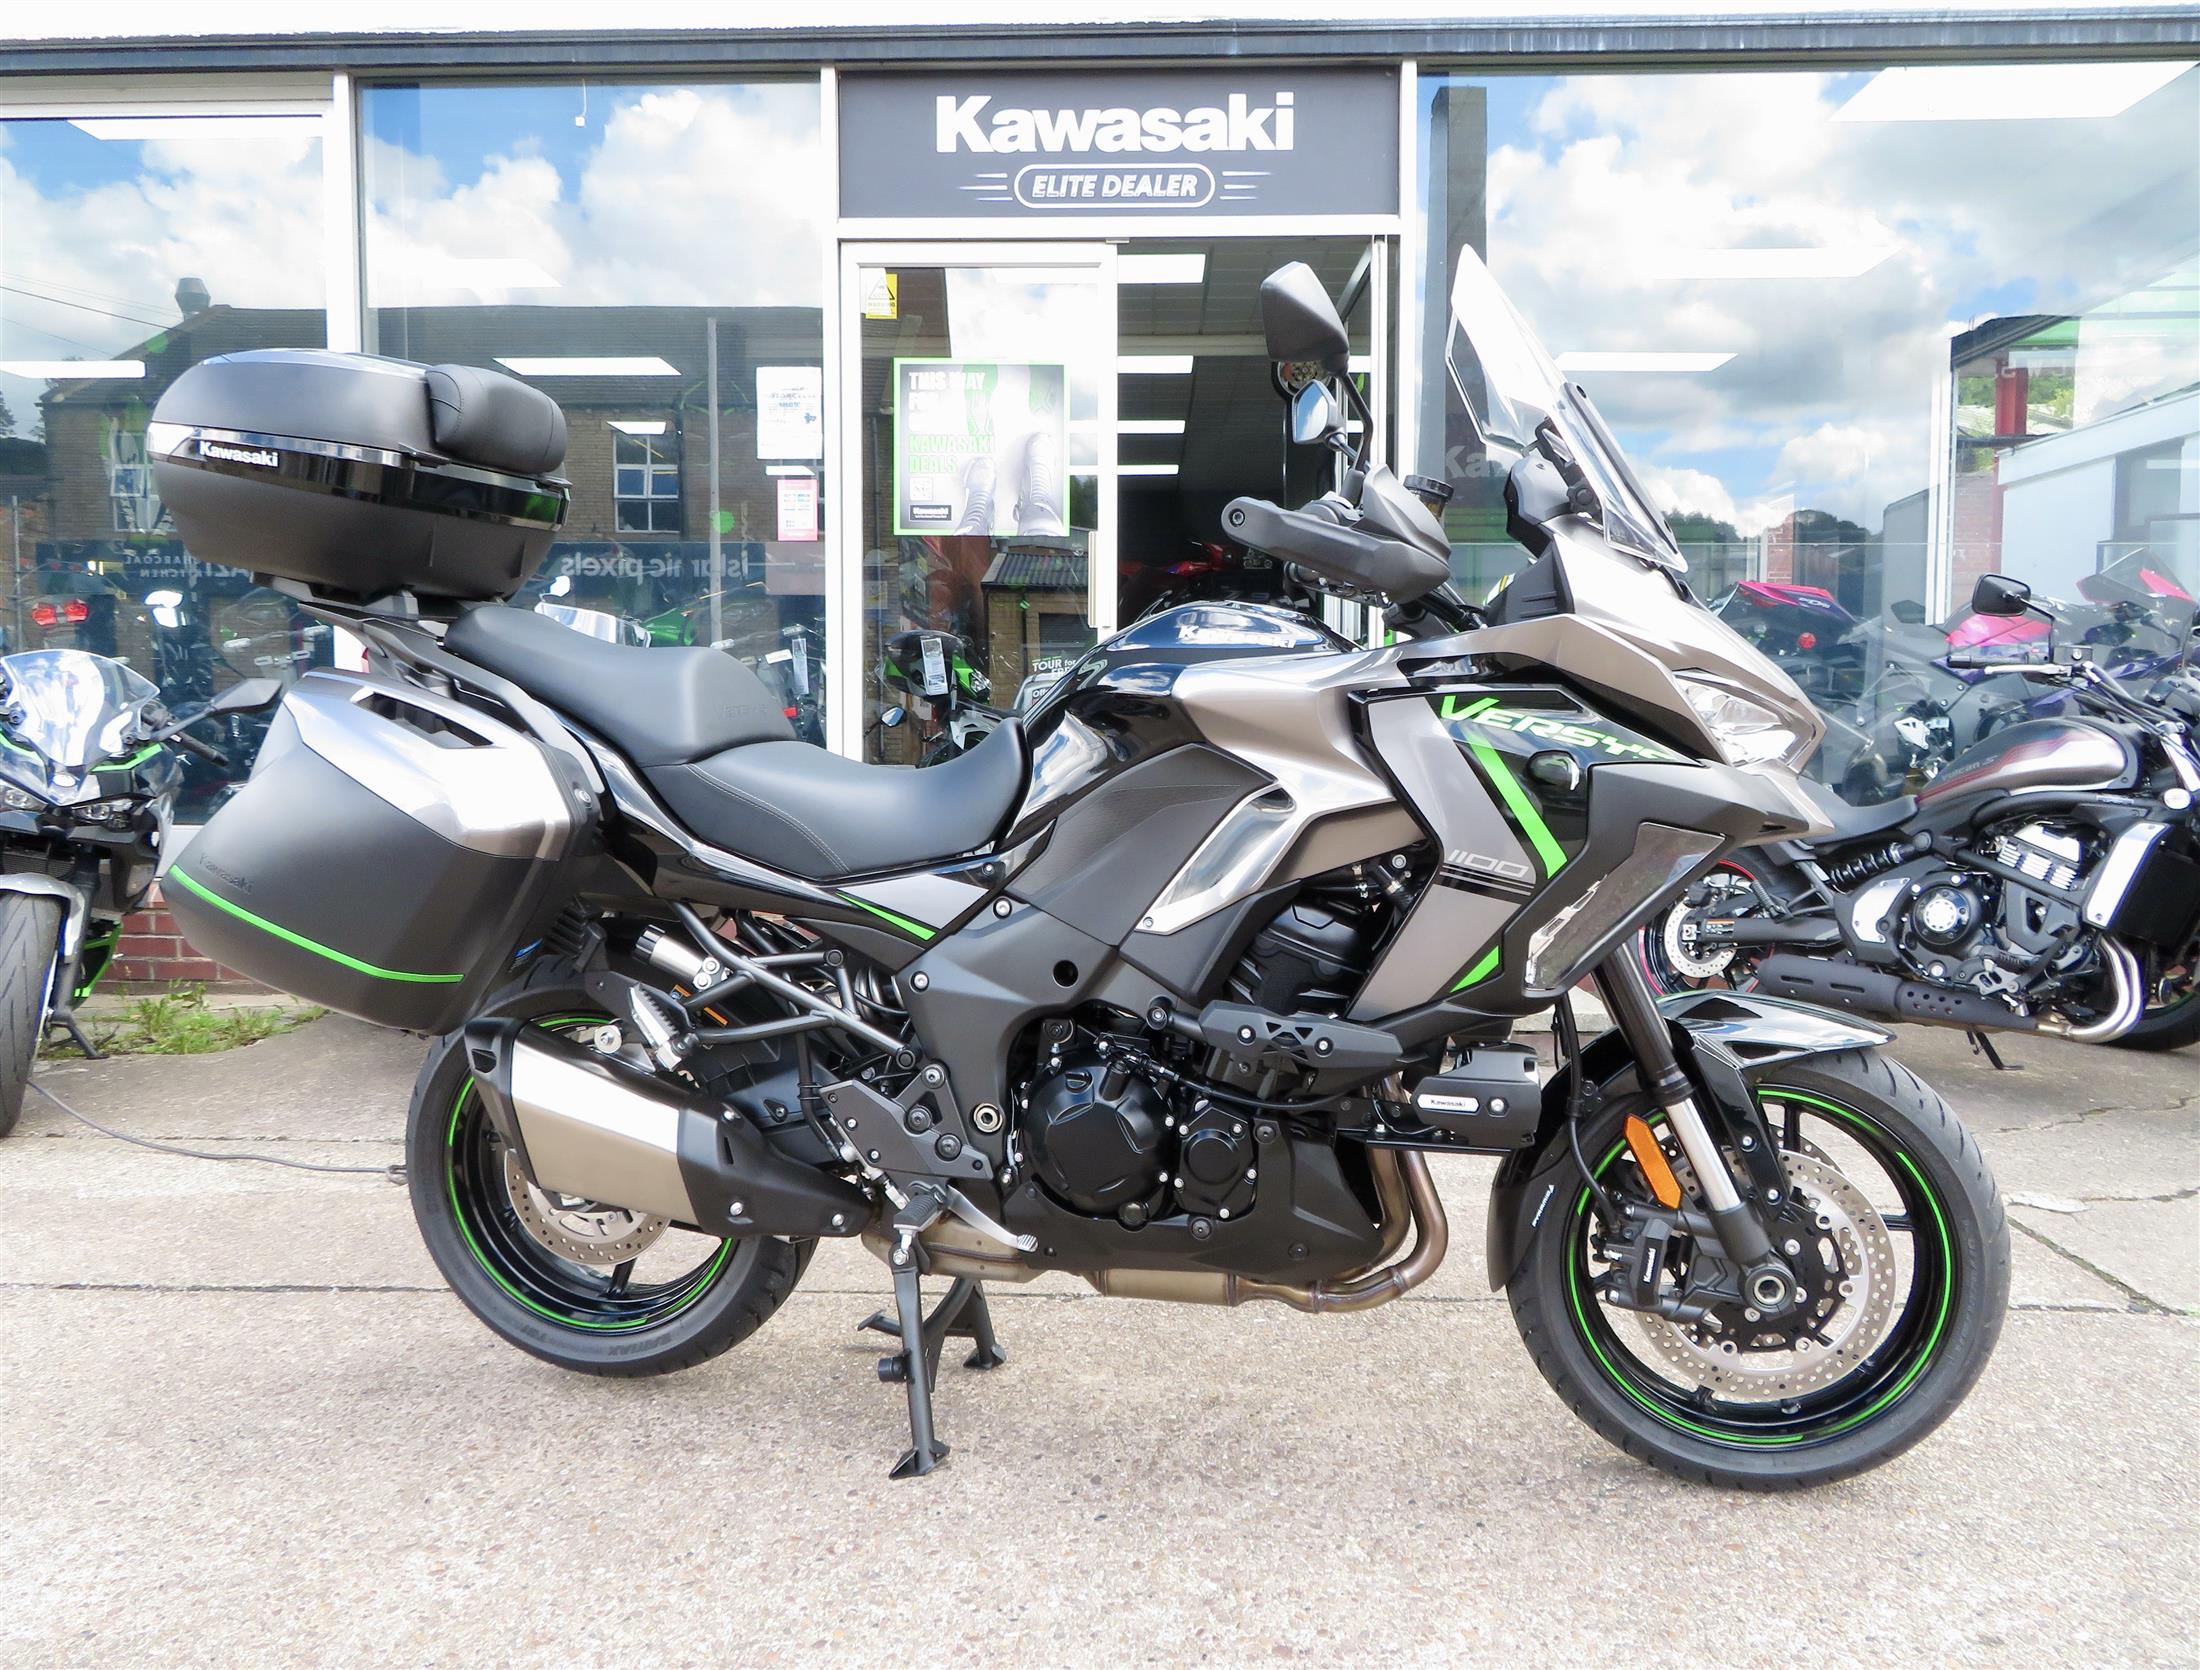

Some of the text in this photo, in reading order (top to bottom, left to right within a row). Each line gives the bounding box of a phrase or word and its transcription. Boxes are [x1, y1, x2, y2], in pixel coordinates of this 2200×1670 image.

[935, 91, 1295, 153] Kawasaki
[1031, 173, 1198, 198] ELITE DEALER
[199, 440, 279, 467] Kawasaki
[909, 434, 993, 453] KAWASAKI
[909, 455, 957, 473] DEALS
[1032, 659, 1062, 672] TOUR
[1447, 849, 1529, 878] 1100
[1430, 1099, 1466, 1108] Kawasaki
